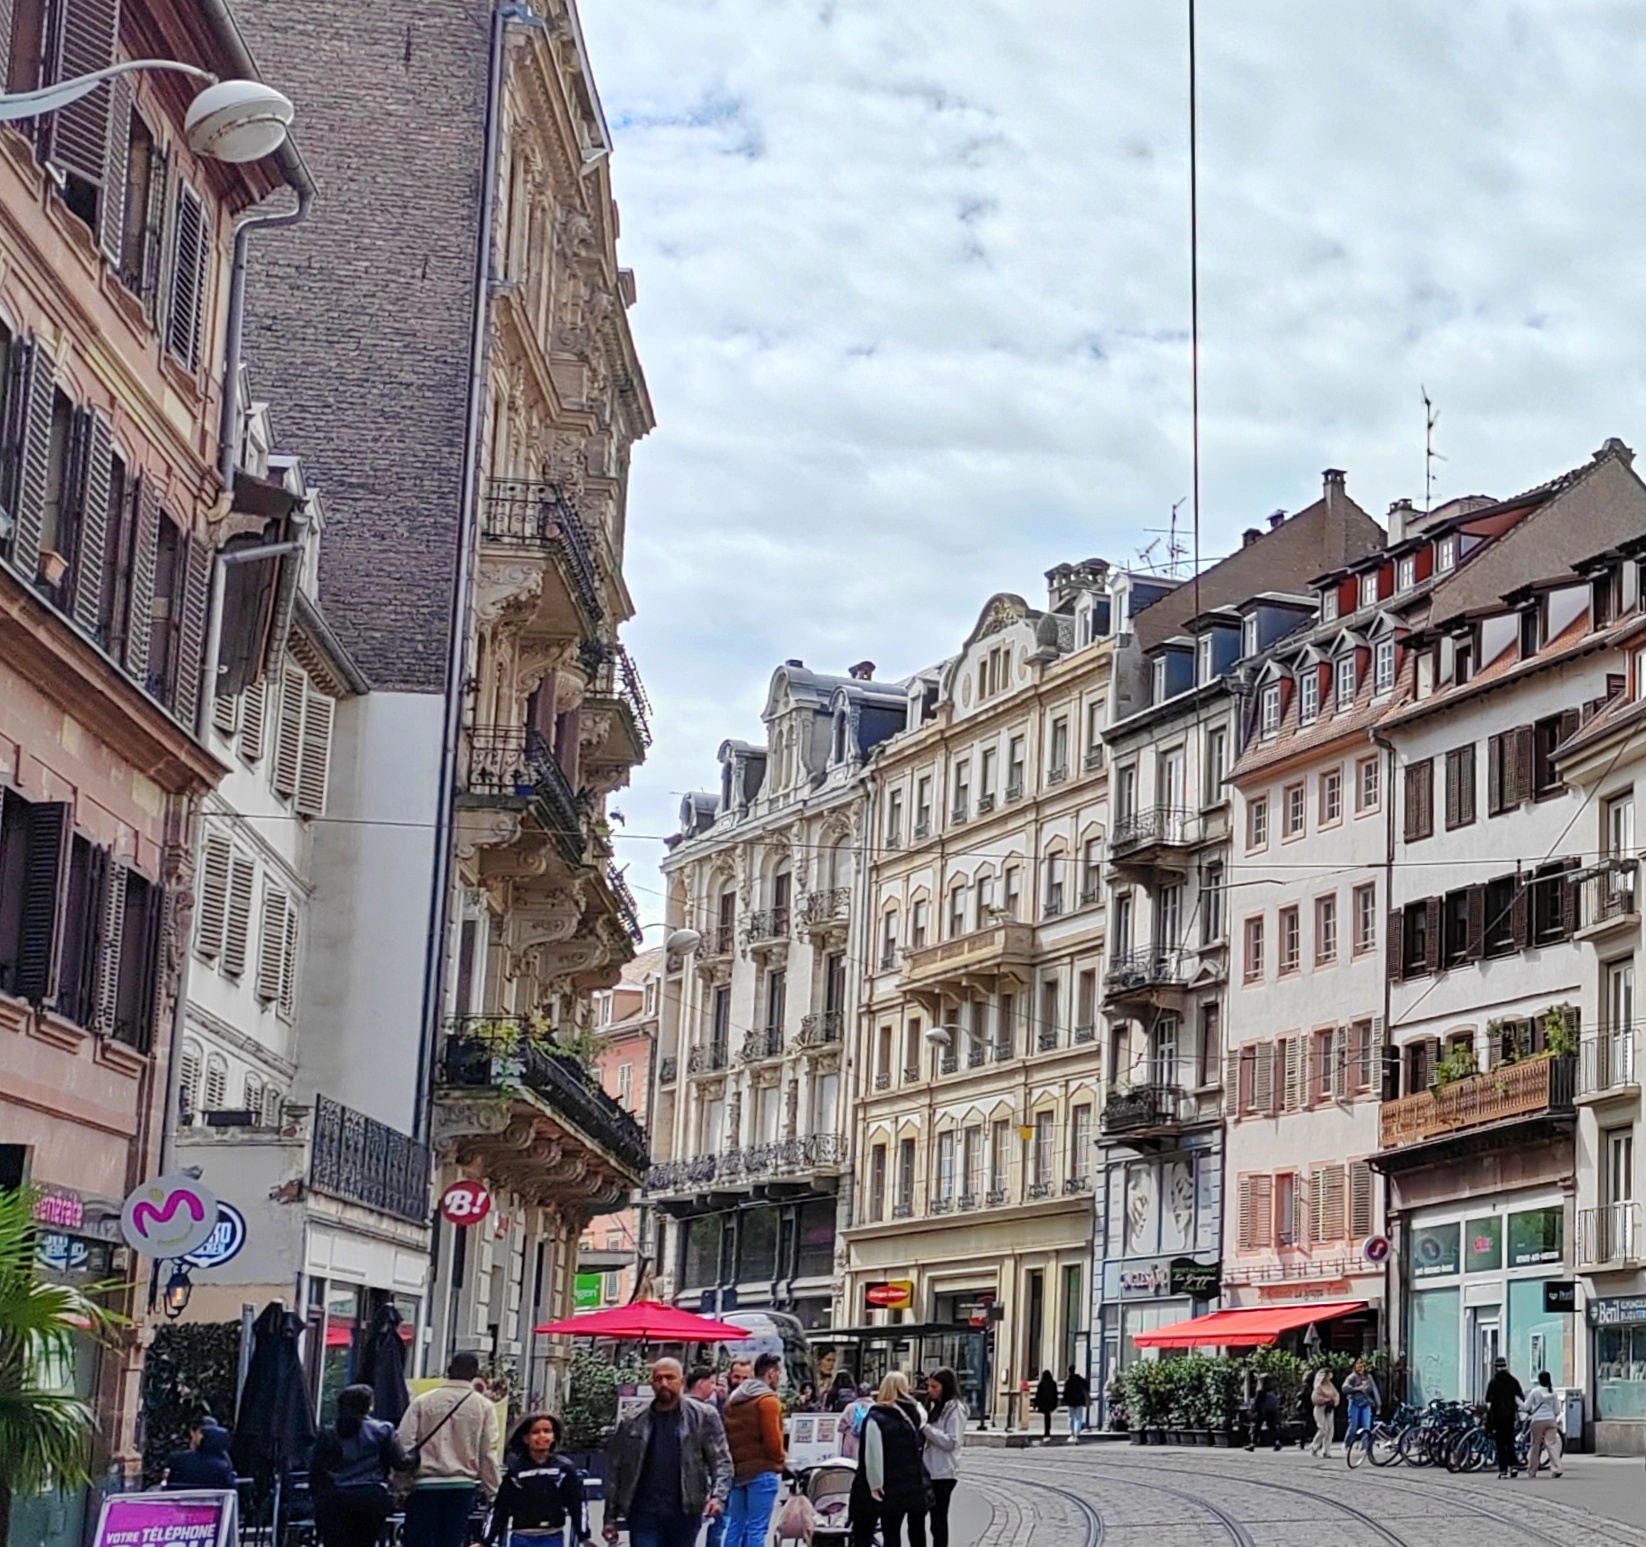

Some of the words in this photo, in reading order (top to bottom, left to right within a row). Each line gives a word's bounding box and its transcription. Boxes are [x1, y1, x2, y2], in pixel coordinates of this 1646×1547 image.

[445, 1189, 487, 1215] B!
[106, 1531, 140, 1543] VOTRE
[142, 1523, 216, 1540] TÉLÉPHONE
